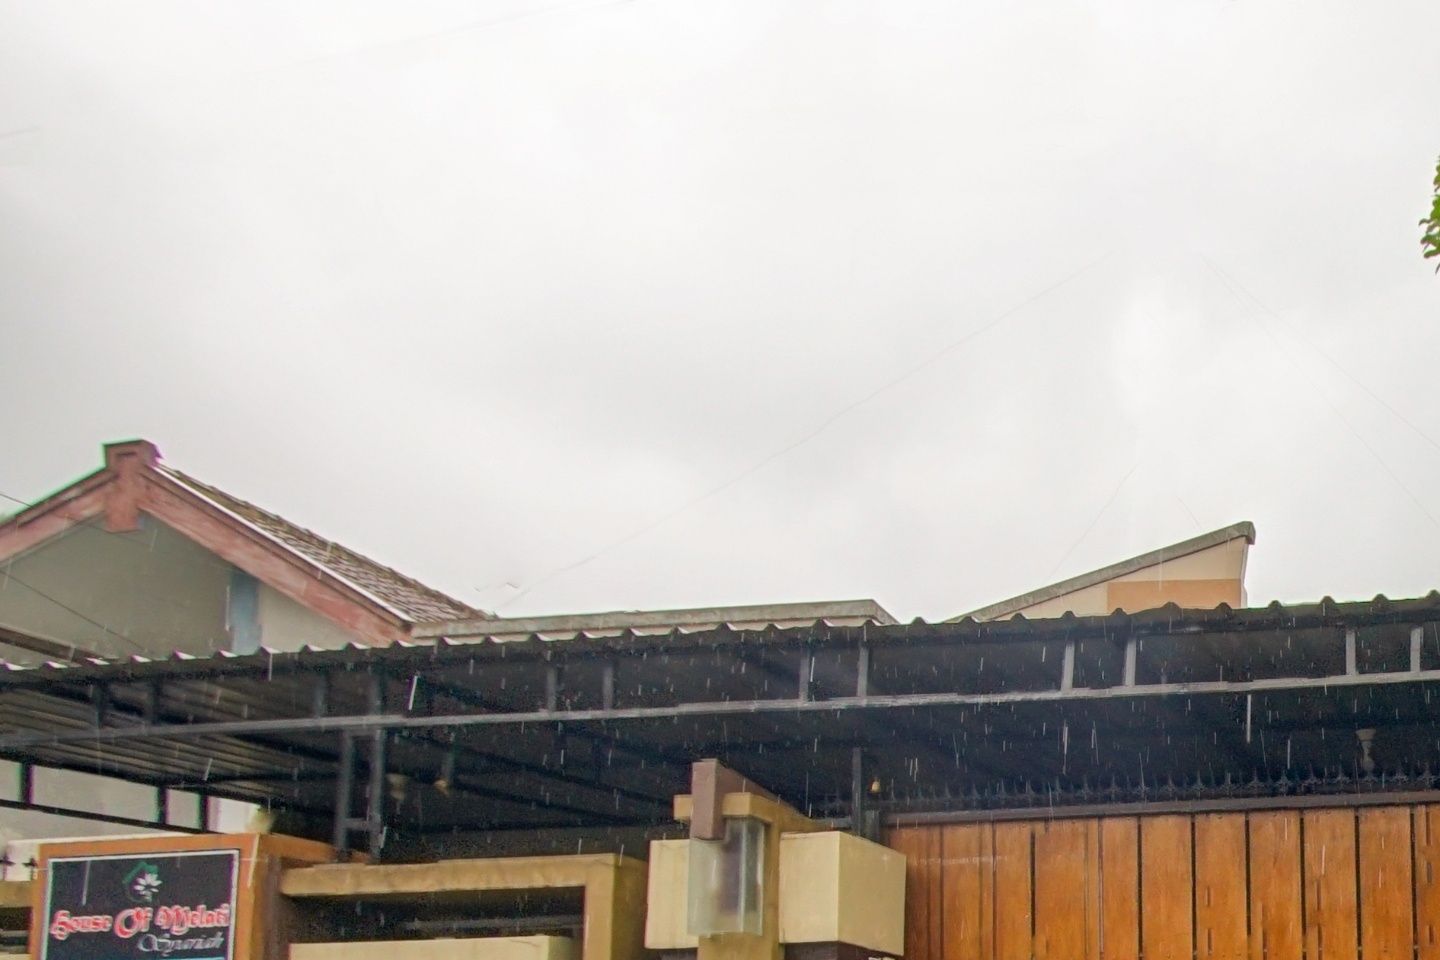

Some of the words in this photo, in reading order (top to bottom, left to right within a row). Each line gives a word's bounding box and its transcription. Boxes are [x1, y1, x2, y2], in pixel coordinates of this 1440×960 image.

[50, 910, 113, 940] House
[114, 907, 153, 938] Of
[155, 903, 230, 935] Melati
